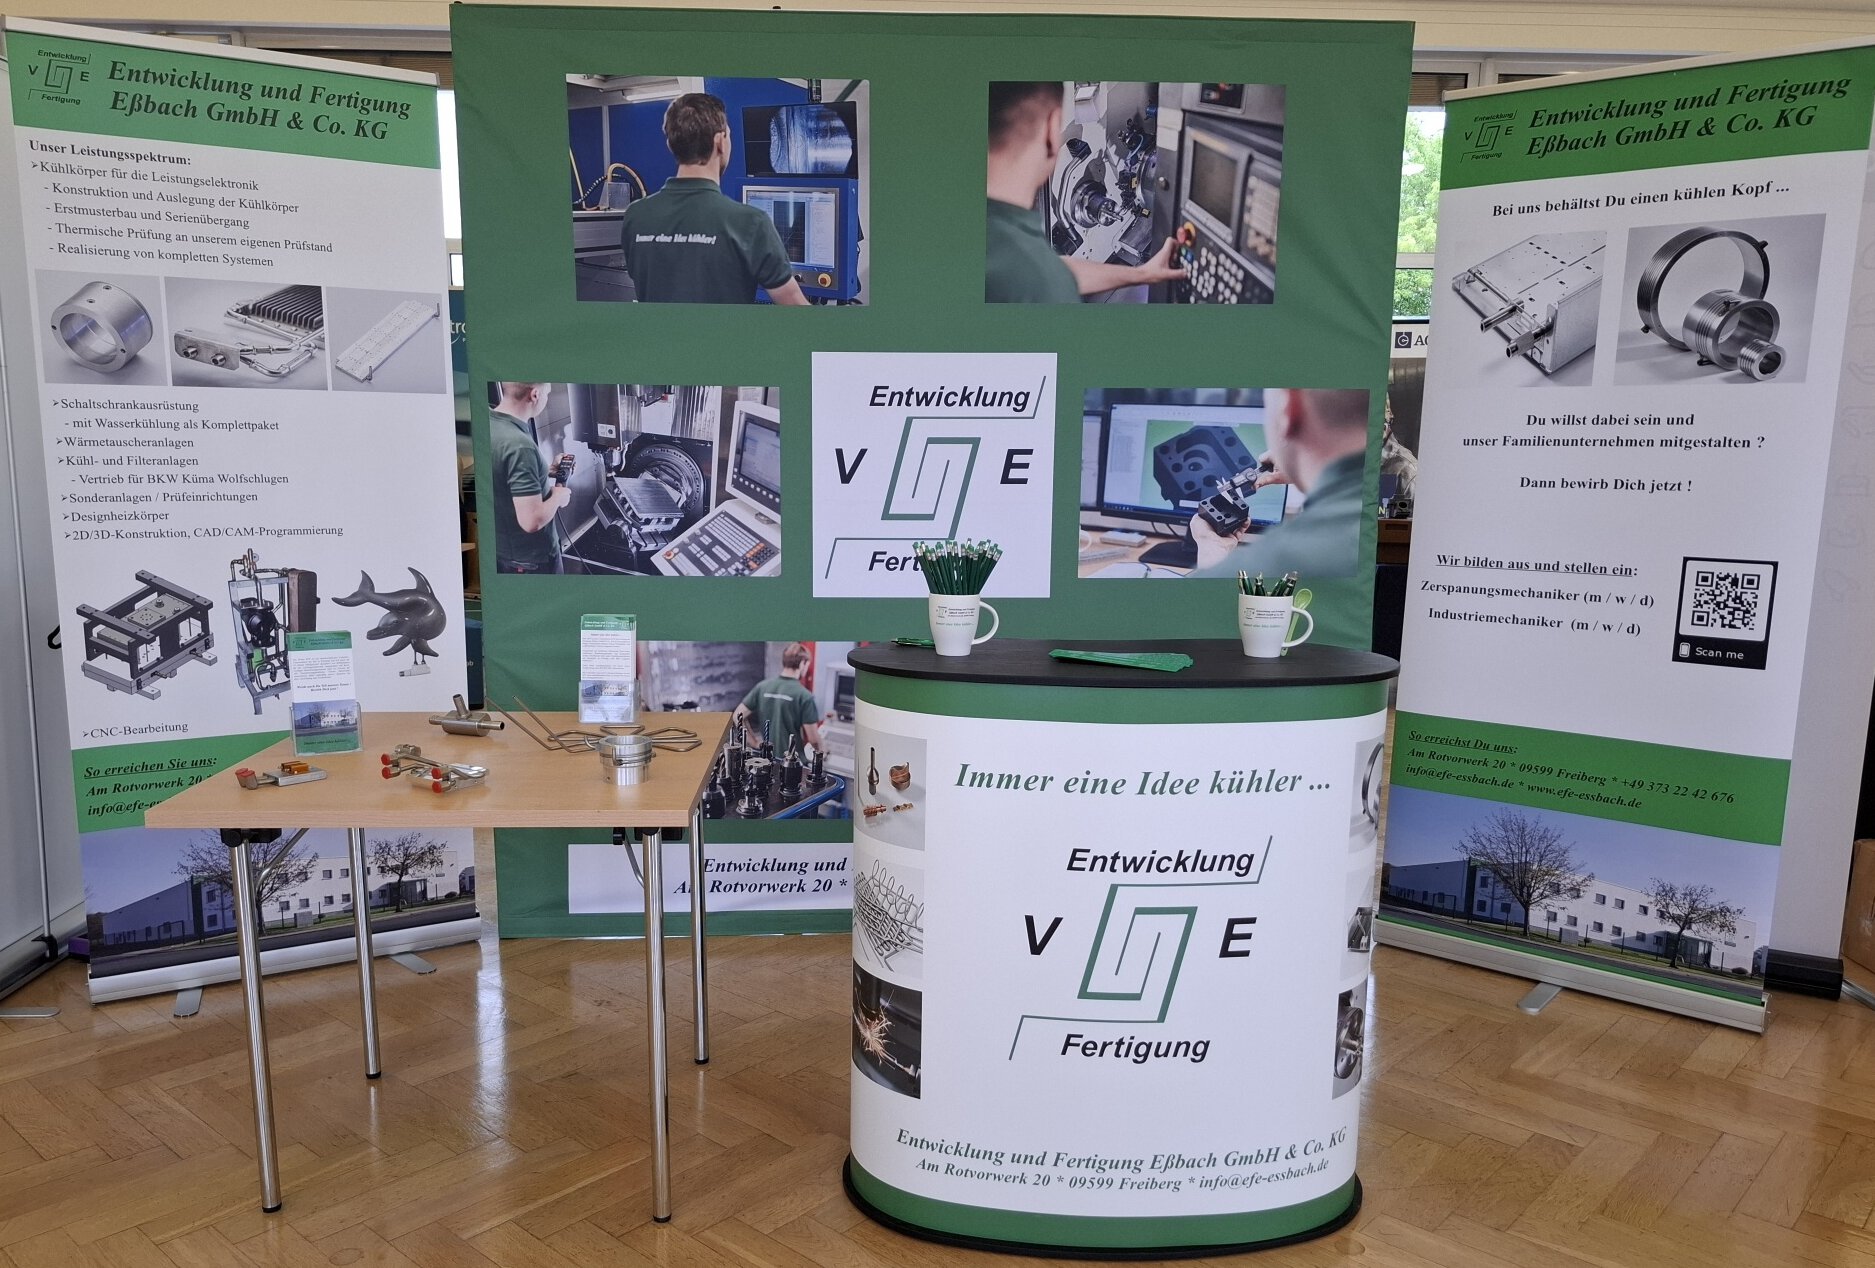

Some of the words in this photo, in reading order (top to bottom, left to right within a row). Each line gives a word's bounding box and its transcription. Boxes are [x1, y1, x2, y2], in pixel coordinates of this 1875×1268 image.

[28, 64, 38, 75] V
[80, 71, 90, 82] E
[107, 60, 254, 101] Entwicklung
[260, 83, 303, 102] und
[308, 85, 412, 121] Fertigung
[109, 90, 198, 119] Eßbach
[206, 101, 281, 128] GmbH
[286, 111, 305, 131] &
[312, 114, 346, 136] Co.
[352, 118, 389, 140] KG
[1527, 98, 1669, 129] Entwicklung
[1673, 86, 1722, 112] und
[1726, 78, 1853, 105] Fertigung
[1465, 131, 1474, 141] V
[1505, 125, 1514, 135] E
[1525, 129, 1607, 160] Eßbach
[1615, 119, 1692, 146] GmbH
[1696, 116, 1717, 137] &
[1726, 113, 1764, 134] Co.
[1772, 105, 1818, 129] KG
[28, 139, 67, 154] Unser
[70, 143, 191, 166] Leistungsspektrum:
[39, 160, 108, 180] Kühlkörper
[110, 167, 128, 180] für
[130, 169, 149, 181] die
[151, 171, 259, 191] Leistungselektronik
[52, 182, 129, 199] Konstruktion
[131, 190, 154, 201] und
[156, 191, 216, 209] Auslegung
[218, 196, 236, 208] der
[238, 197, 300, 215] Kühlkörper
[1492, 203, 1514, 217] Bei
[1517, 204, 1541, 215] uns
[1545, 197, 1601, 212] behältst
[1605, 195, 1626, 208] Du
[1630, 192, 1669, 205] einen
[1673, 186, 1726, 201] kühlen
[1731, 180, 1774, 198] Kopf
[54, 202, 138, 219] Erstmusterbau
[140, 210, 162, 221] und
[164, 210, 250, 231] Serienübergang
[54, 222, 124, 238] Thermische
[126, 227, 173, 244] Prüfung
[175, 233, 189, 242] an
[191, 235, 237, 246] unserem
[239, 235, 282, 250] eigenen
[284, 239, 333, 253] Prüfstand
[57, 242, 131, 261] Realisierung
[132, 250, 155, 259] von
[157, 248, 219, 264] kompletten
[222, 253, 274, 267] Systemen
[60, 398, 200, 414] Schaltschrankausrüstung
[869, 386, 1030, 412] Entwicklung
[72, 417, 92, 428] mit
[94, 417, 181, 432] Wasserkühlung
[183, 419, 199, 430] als
[201, 419, 279, 433] Komplettpaket
[1526, 414, 1546, 426] Du
[1550, 414, 1587, 426] willst
[1591, 413, 1630, 426] dabei
[1633, 413, 1661, 426] sein
[1666, 413, 1695, 426] und
[63, 436, 194, 450] Wärmetauscheranlagen
[1463, 438, 1499, 447] unser
[1502, 435, 1655, 448] Familienunternehmen
[1659, 435, 1751, 451] mitgestalten
[65, 455, 99, 466] Kühl-
[102, 455, 124, 466] und
[126, 455, 199, 469] Filteranlagen
[835, 448, 868, 484] V
[1000, 449, 1034, 484] E
[78, 473, 125, 485] Vertrieb
[127, 473, 144, 484] für
[146, 473, 179, 484] BKW
[181, 473, 215, 484] Küma
[217, 473, 289, 486] Wolfschlugen
[1519, 476, 1556, 489] Dann
[1560, 477, 1609, 490] bewirb
[1613, 478, 1646, 491] Dich
[1648, 479, 1682, 494] jetzt
[69, 492, 152, 505] Sonderanlagen
[162, 491, 258, 504] Prüfeinrichtungen
[71, 510, 170, 524] Designheizkörper
[72, 528, 191, 541] 2D/3D-Konstruktion,
[193, 525, 344, 538] CAD/CAM-Programmierung
[1436, 554, 1461, 566] Wir
[1464, 556, 1503, 569] bilden
[1508, 561, 1530, 570] aus
[1534, 560, 1560, 572] und
[1564, 561, 1608, 574] stellen
[1612, 563, 1638, 576] ein:
[1420, 580, 1580, 601] Zerspanungsmechaniker
[1428, 607, 1564, 628] Industriemechaniker
[1695, 647, 1722, 658] Scan
[1726, 650, 1744, 660] me
[90, 723, 189, 739] CNC-Bearbeitung
[1408, 730, 1422, 743] So
[1424, 734, 1471, 750] erreichst
[1474, 738, 1490, 751] Du
[1493, 743, 1518, 754] uns:
[84, 767, 100, 779] So
[105, 760, 164, 777] erreichen
[168, 758, 187, 769] Sie
[191, 757, 217, 768] uns:
[954, 763, 1054, 791] Immer
[1064, 770, 1126, 795] eine
[1136, 771, 1200, 796] Idee
[1209, 768, 1303, 794] kühler
[1406, 747, 1425, 759] Am
[1427, 750, 1490, 768] Rotvorwerk
[1491, 759, 1507, 770] 20
[1518, 762, 1554, 777] 09599
[1555, 768, 1607, 787] Freiberg
[1621, 778, 1645, 790] +49
[1646, 781, 1670, 794] 373
[1672, 785, 1689, 797] 22
[1691, 788, 1708, 800] 42
[1710, 791, 1735, 804] 676
[86, 786, 107, 797] Am
[112, 777, 184, 793] Rotvorwerk
[188, 775, 202, 786] 20
[1405, 765, 1515, 789] info@efe-essbach.de
[1527, 784, 1643, 809] www.efe-essbach.de
[704, 859, 808, 875] Entwicklung
[814, 857, 847, 872] und
[1066, 847, 1255, 877] Entwicklung
[710, 879, 806, 894] Rotvorwerk
[812, 878, 832, 892] 20
[1024, 914, 1063, 955] V
[1219, 917, 1257, 959] E
[1060, 1033, 1210, 1064] Fertigung
[896, 1127, 1006, 1166] Entwicklung
[1010, 1147, 1046, 1168] und
[1052, 1152, 1144, 1174] Fertigung
[1149, 1152, 1218, 1172] Eßbach
[1224, 1146, 1280, 1166] GmbH
[1284, 1144, 1298, 1161] &
[1303, 1135, 1325, 1155] Co.
[1328, 1125, 1347, 1150] KG
[916, 1157, 940, 1174] Am
[944, 1162, 1028, 1186] Rotvorwerk
[1032, 1173, 1051, 1187] 20
[1069, 1174, 1114, 1190] 09599
[1119, 1175, 1182, 1193] Freiberg
[1199, 1157, 1329, 1191] info@efe-essbach.de
